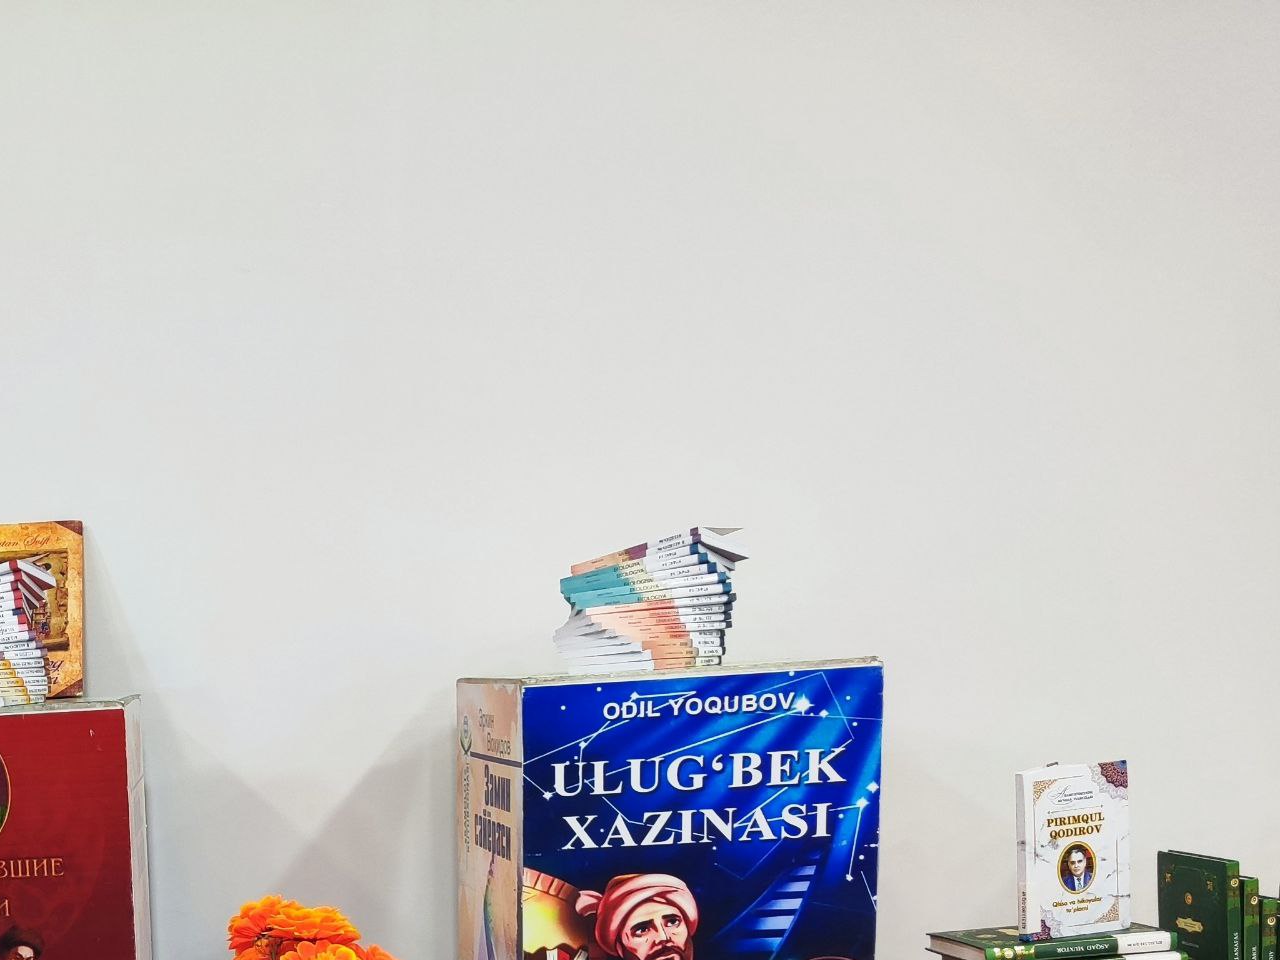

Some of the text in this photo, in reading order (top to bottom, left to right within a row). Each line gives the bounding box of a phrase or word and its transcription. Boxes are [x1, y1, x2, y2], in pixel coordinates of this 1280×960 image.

[602, 691, 795, 721] ODIL YOQUBOV
[551, 747, 846, 797] ULUG‘BEK
[561, 802, 833, 851] XAZINASI
[1046, 812, 1104, 827] PIRIMQUL
[1049, 824, 1102, 839] QODIROV
